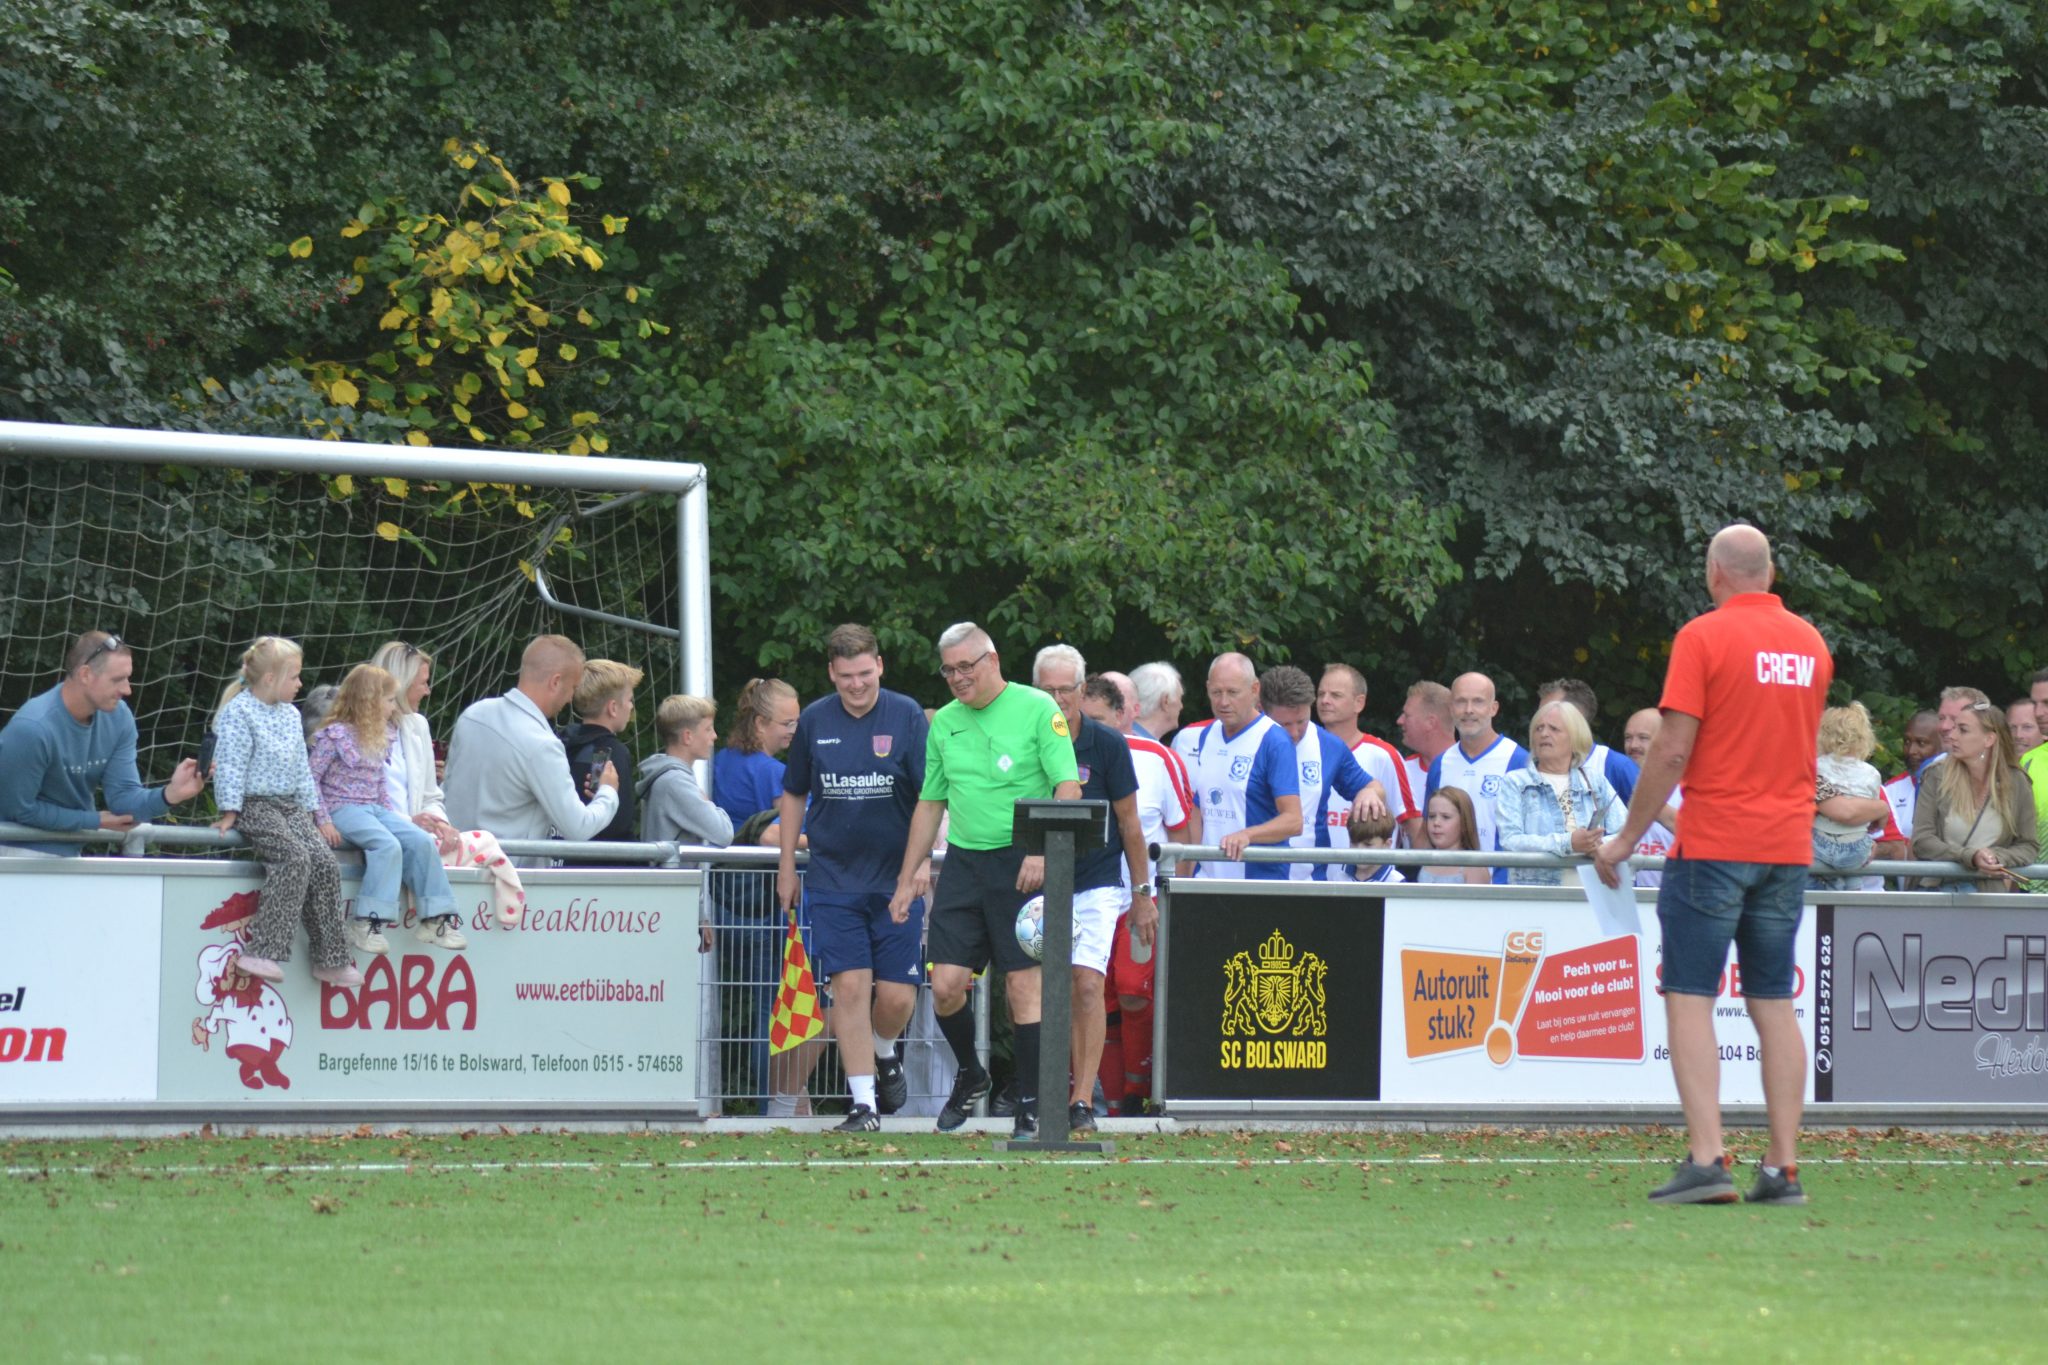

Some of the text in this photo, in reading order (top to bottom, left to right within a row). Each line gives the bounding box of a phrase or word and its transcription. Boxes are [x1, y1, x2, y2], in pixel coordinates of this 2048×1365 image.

[1756, 651, 1815, 687] CREW
[831, 771, 894, 788] Lasaulec
[1201, 808, 1237, 820] OUWER
[472, 901, 494, 931] &
[503, 898, 661, 933] teakhouse
[1507, 931, 1543, 951] GG
[1563, 959, 1632, 978] Pech voor u..
[516, 979, 664, 1003] www.eetbijbaba.nl
[1413, 965, 1489, 1001] Autoruit
[1535, 976, 1634, 1004] Mooi voor de club!
[1820, 934, 1832, 1045] 0515-572 626
[1428, 1005, 1475, 1041] stuk?
[1537, 1007, 1635, 1030] Laat bij ons uw ruit vervangen
[1550, 1021, 1634, 1043] en help daarmee de club!
[319, 1053, 397, 1075] Bargefenne
[403, 1053, 438, 1071] 15/16
[443, 1054, 454, 1071] te
[459, 1054, 526, 1074] Bolsward,
[532, 1054, 588, 1072] Telefoon
[593, 1054, 624, 1072] 0515
[637, 1055, 683, 1072] 574658
[1221, 1041, 1326, 1069] SC BOLSWARD
